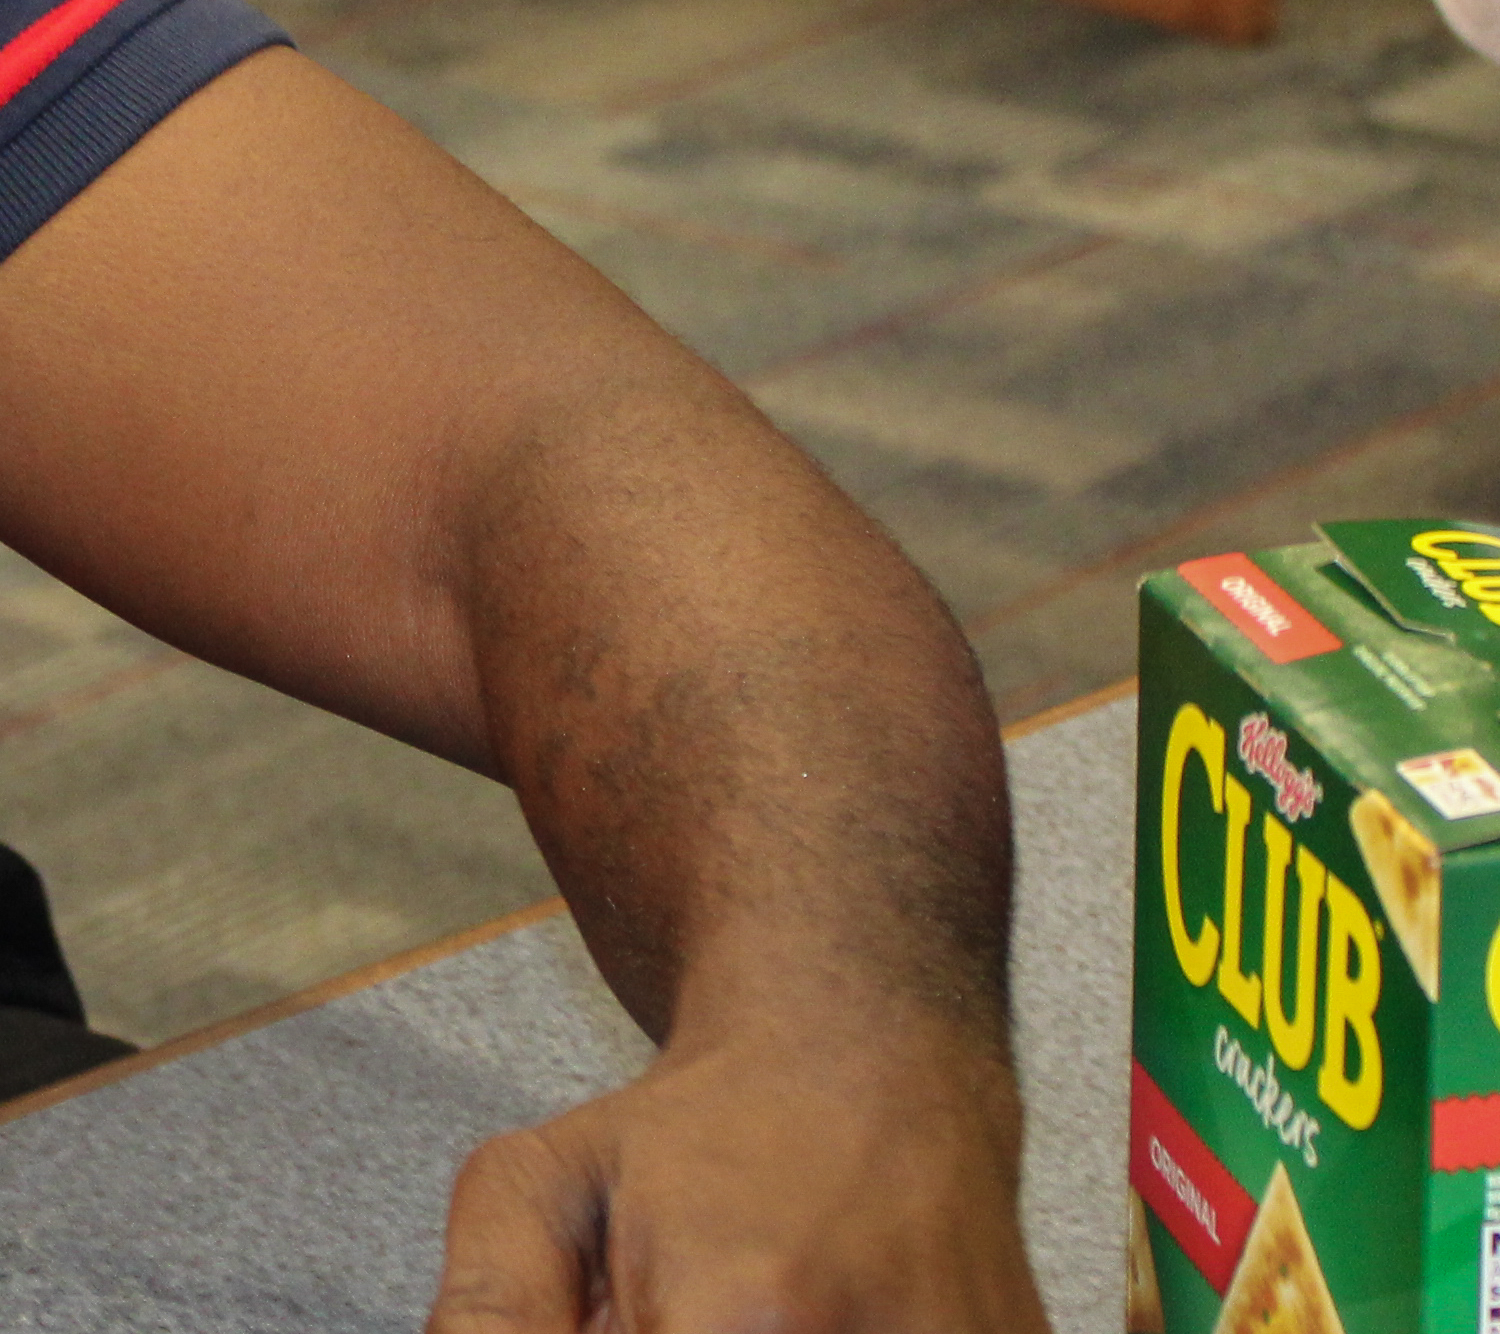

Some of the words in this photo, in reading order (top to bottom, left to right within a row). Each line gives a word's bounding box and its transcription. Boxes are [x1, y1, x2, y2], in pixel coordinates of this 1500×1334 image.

[1221, 575, 1293, 638] ORIGINAL
[1238, 710, 1323, 823] Kellogg's
[1162, 704, 1383, 1130] CLUB
[1214, 1025, 1321, 1169] crackers
[1149, 1134, 1223, 1246] ORIGINAL
